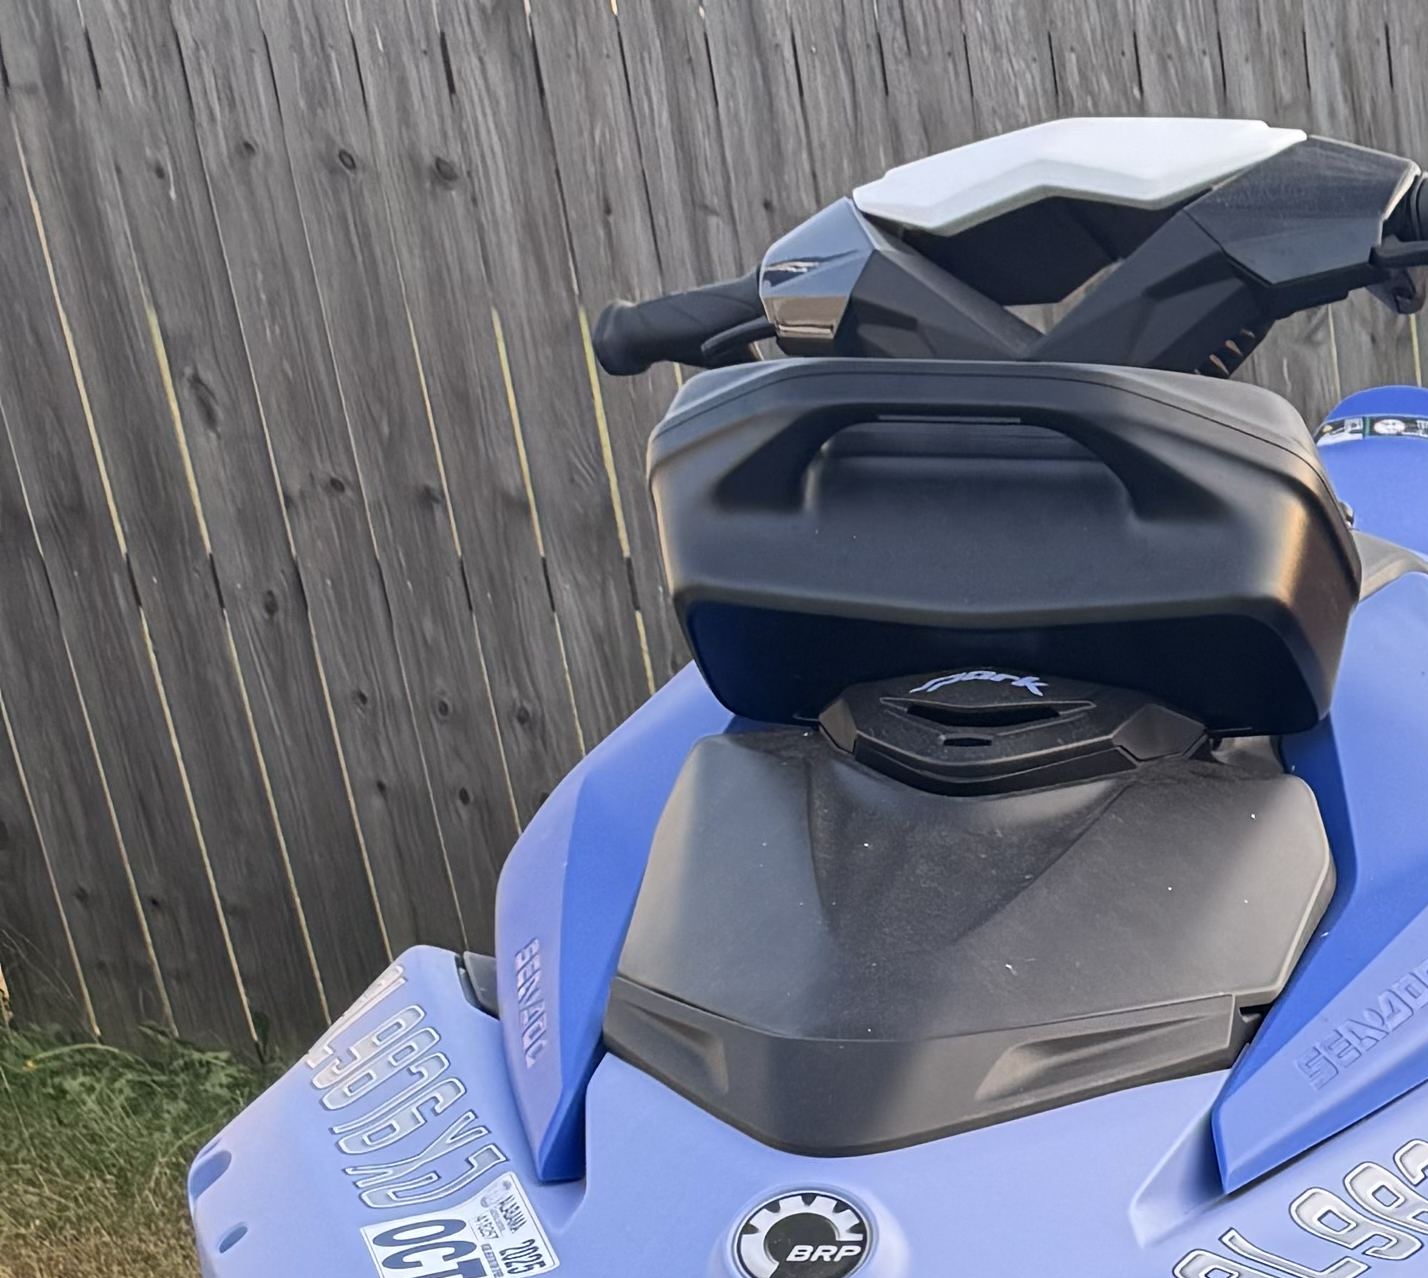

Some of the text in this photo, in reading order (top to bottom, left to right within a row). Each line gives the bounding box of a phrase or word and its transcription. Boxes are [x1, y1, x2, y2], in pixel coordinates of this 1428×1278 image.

[342, 1110, 510, 1208] XJ
[499, 1238, 547, 1274] 2025
[785, 1244, 862, 1262] BRP
